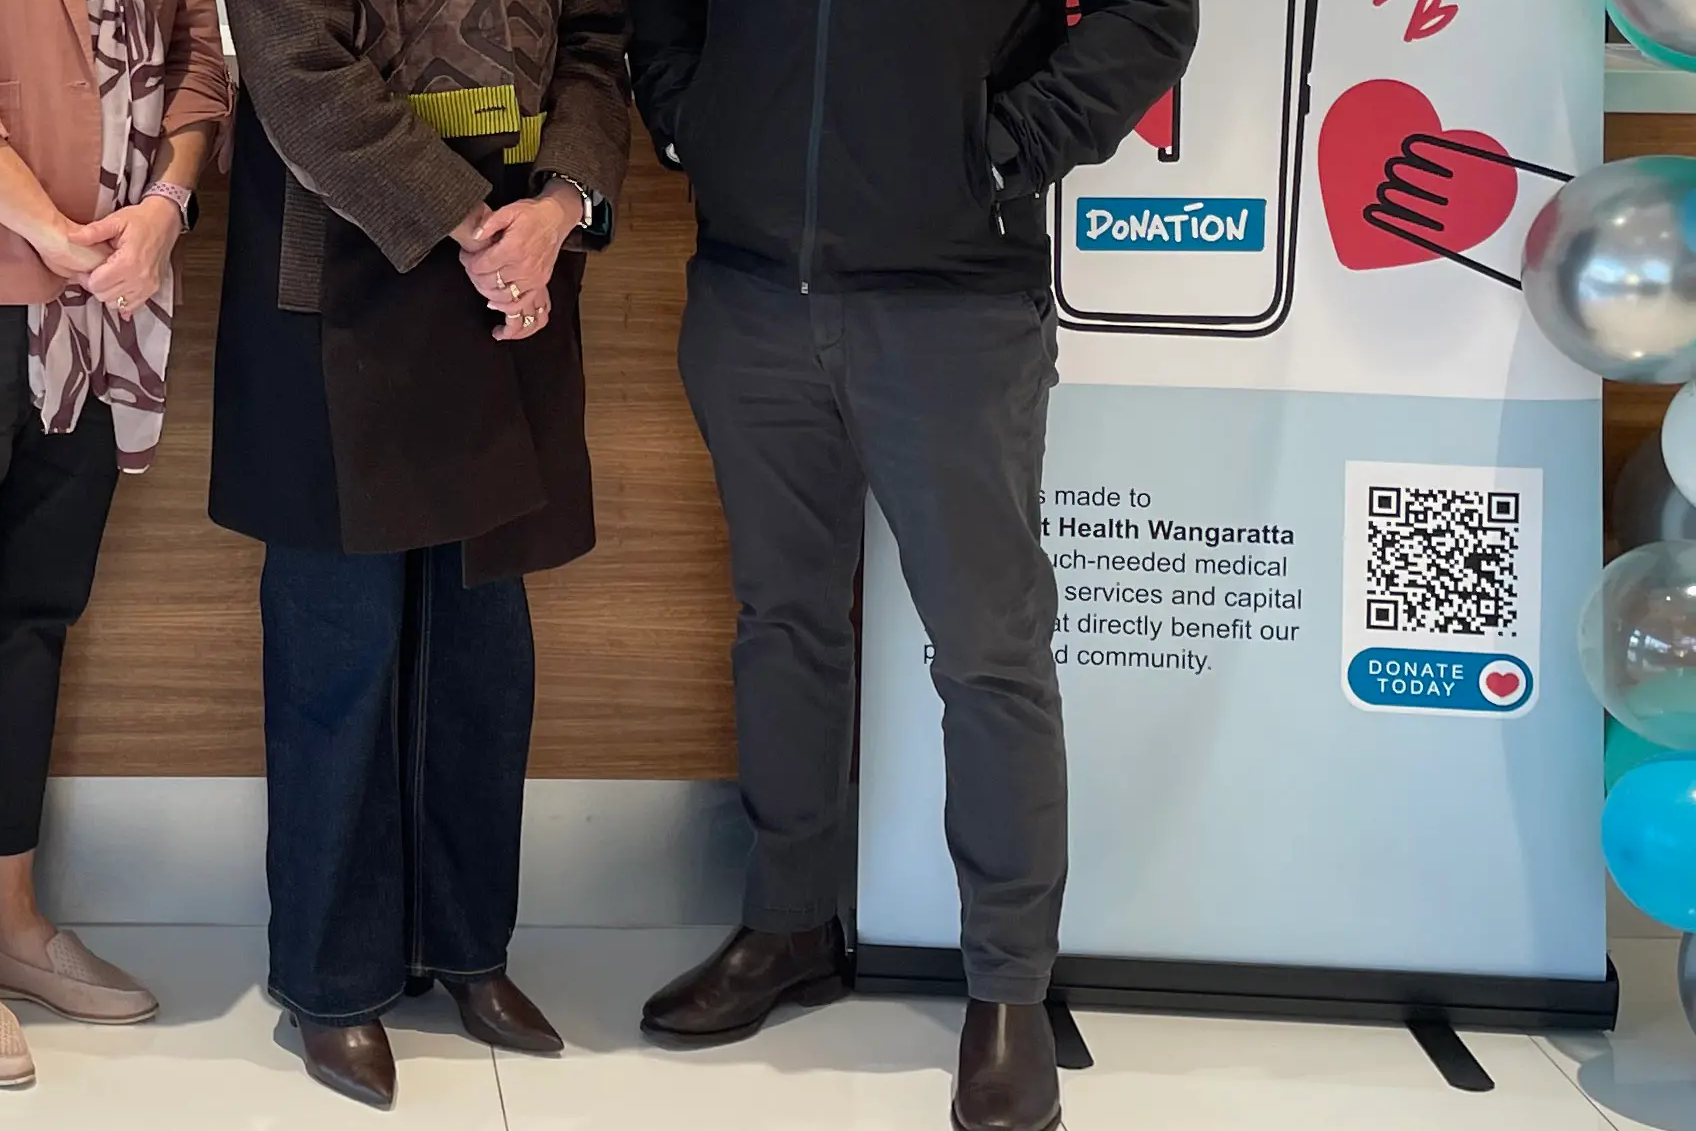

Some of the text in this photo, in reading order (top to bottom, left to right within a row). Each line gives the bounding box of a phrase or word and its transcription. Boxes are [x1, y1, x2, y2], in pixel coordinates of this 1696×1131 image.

[1054, 487, 1121, 508] made
[1129, 488, 1151, 508] to
[1058, 517, 1139, 539] Health
[1148, 519, 1295, 547] Wangaratta
[1053, 549, 1288, 577] ch-needed medical
[1064, 582, 1302, 614] services and capital
[1077, 614, 1163, 641] directly
[1171, 616, 1252, 640] benefit
[1260, 623, 1300, 641] our
[1077, 646, 1212, 676] community.
[1369, 659, 1464, 680] DONATE
[1377, 677, 1456, 697] TODAY
